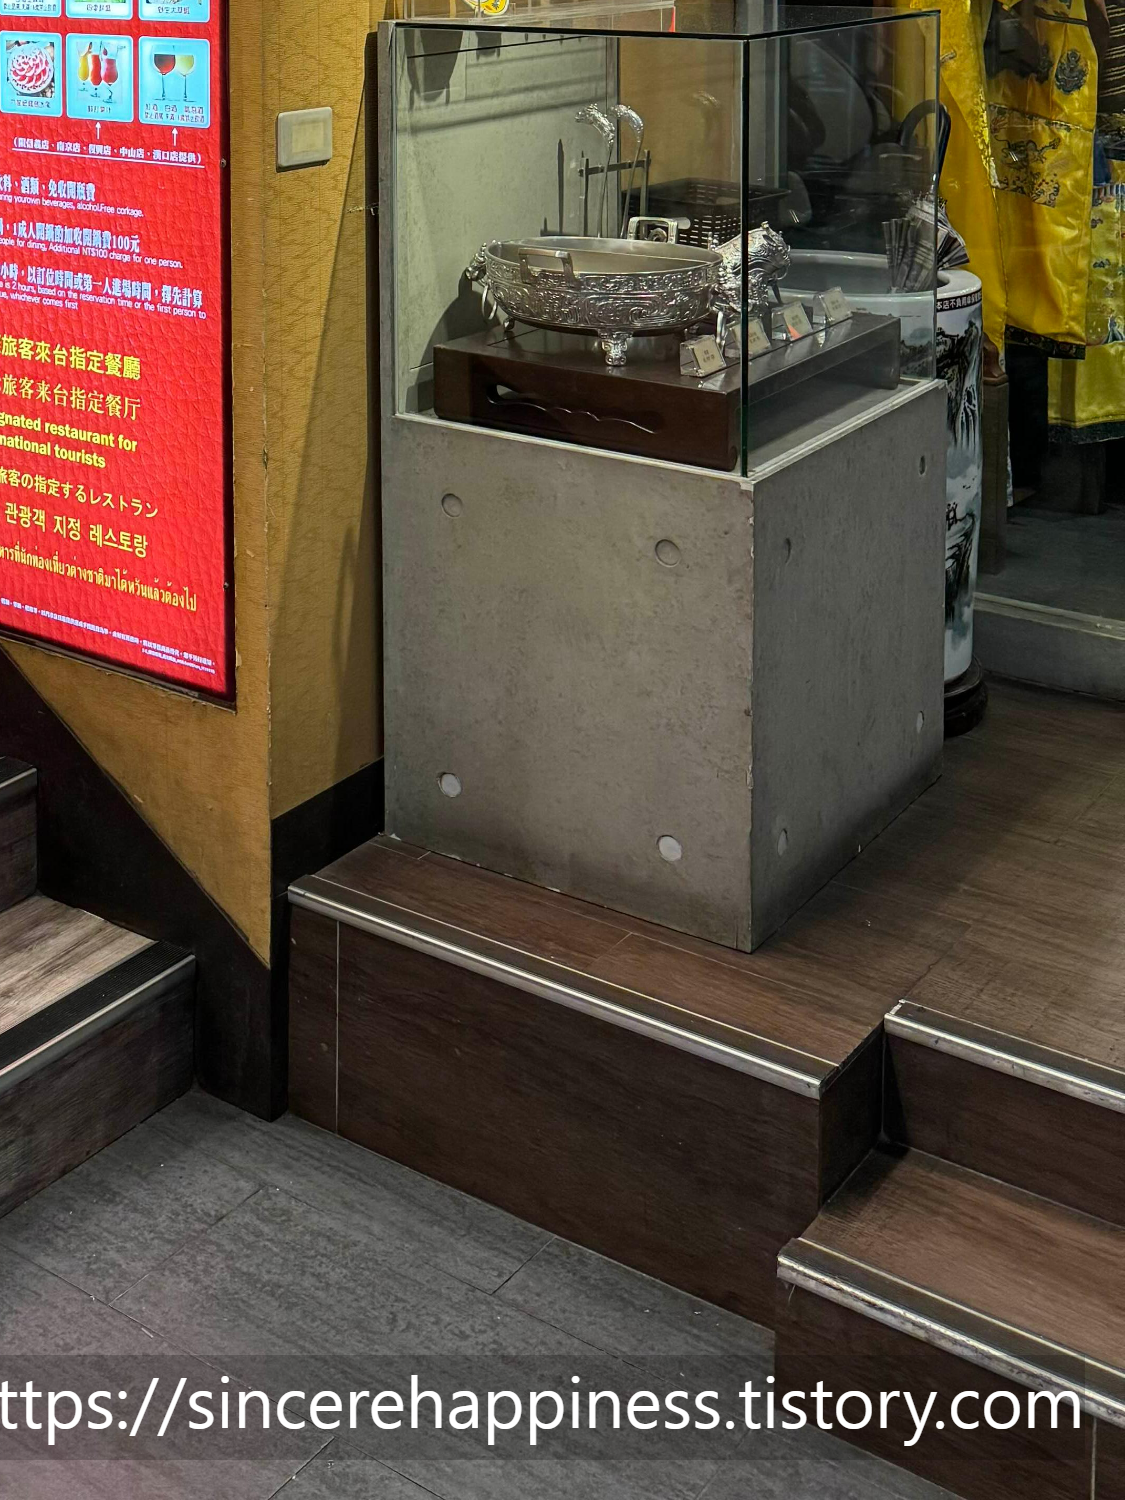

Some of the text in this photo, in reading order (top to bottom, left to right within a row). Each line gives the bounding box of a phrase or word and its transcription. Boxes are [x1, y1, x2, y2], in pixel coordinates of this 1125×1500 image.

[108, 251, 131, 263] charge
[144, 256, 157, 267] one
[158, 257, 184, 270] person.
[17, 281, 37, 294] hours,
[78, 291, 116, 305] reservation
[143, 300, 155, 312] the
[156, 302, 172, 314] first
[172, 305, 198, 319] person
[64, 298, 79, 310] first
[44, 422, 115, 448] restaurant
[118, 434, 138, 453] for
[53, 444, 107, 469] tourists
[4, 501, 46, 533] 관광객
[53, 514, 81, 542] 지정
[88, 523, 148, 559] 레스토랑
